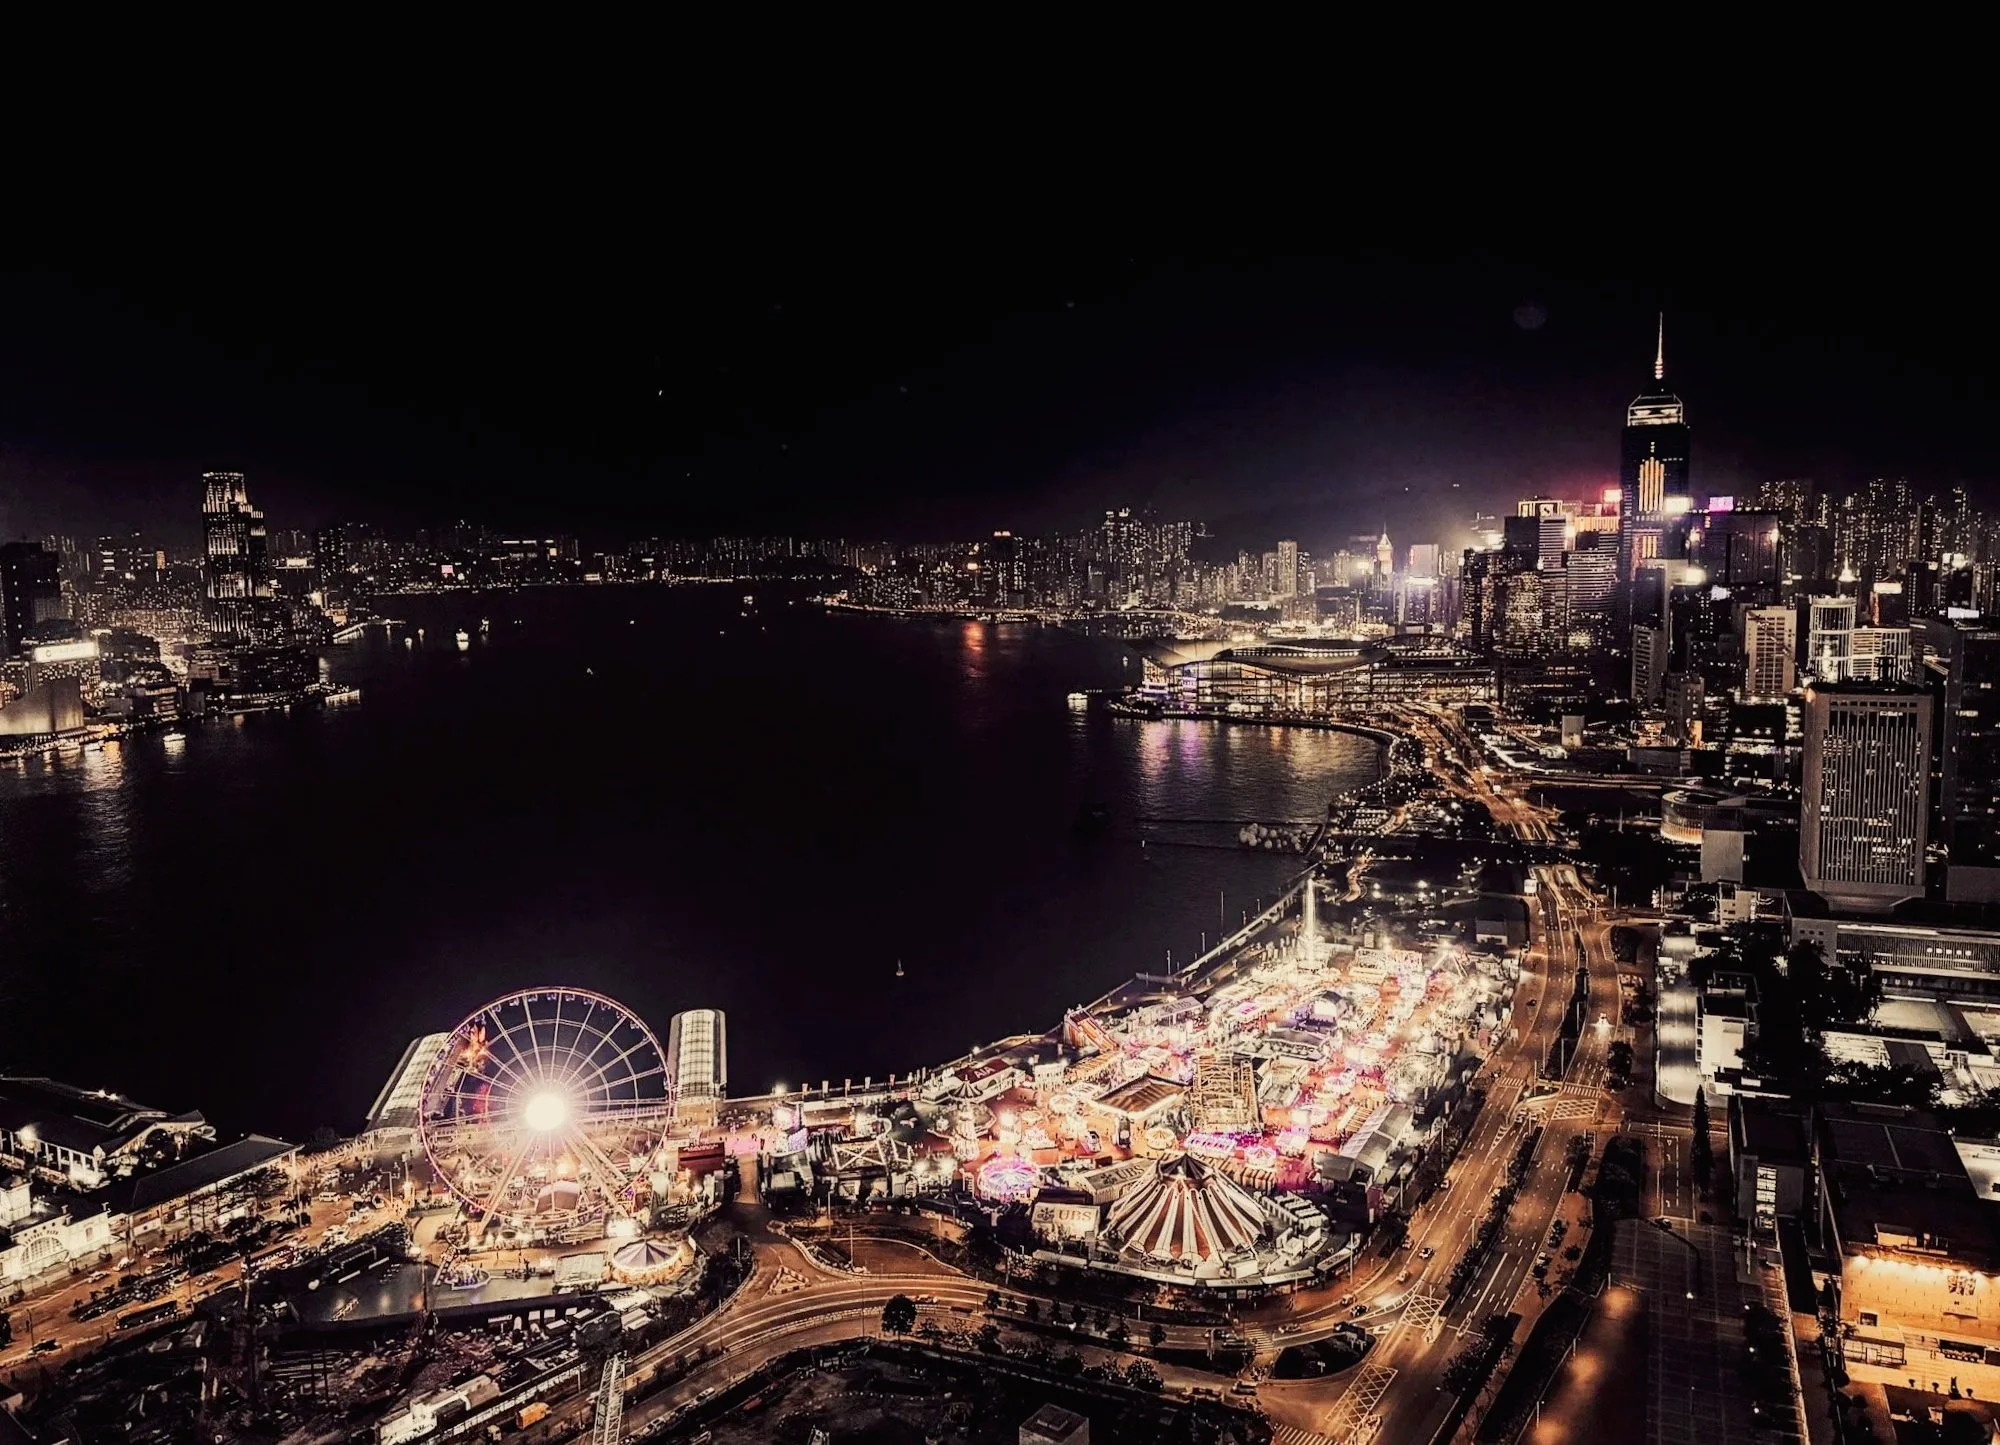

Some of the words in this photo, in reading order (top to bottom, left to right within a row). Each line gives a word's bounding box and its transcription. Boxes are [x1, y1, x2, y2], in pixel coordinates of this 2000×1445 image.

[974, 1067, 996, 1079] AIA
[1115, 1165, 1145, 1180] UBS
[1058, 1210, 1092, 1222] UBS
